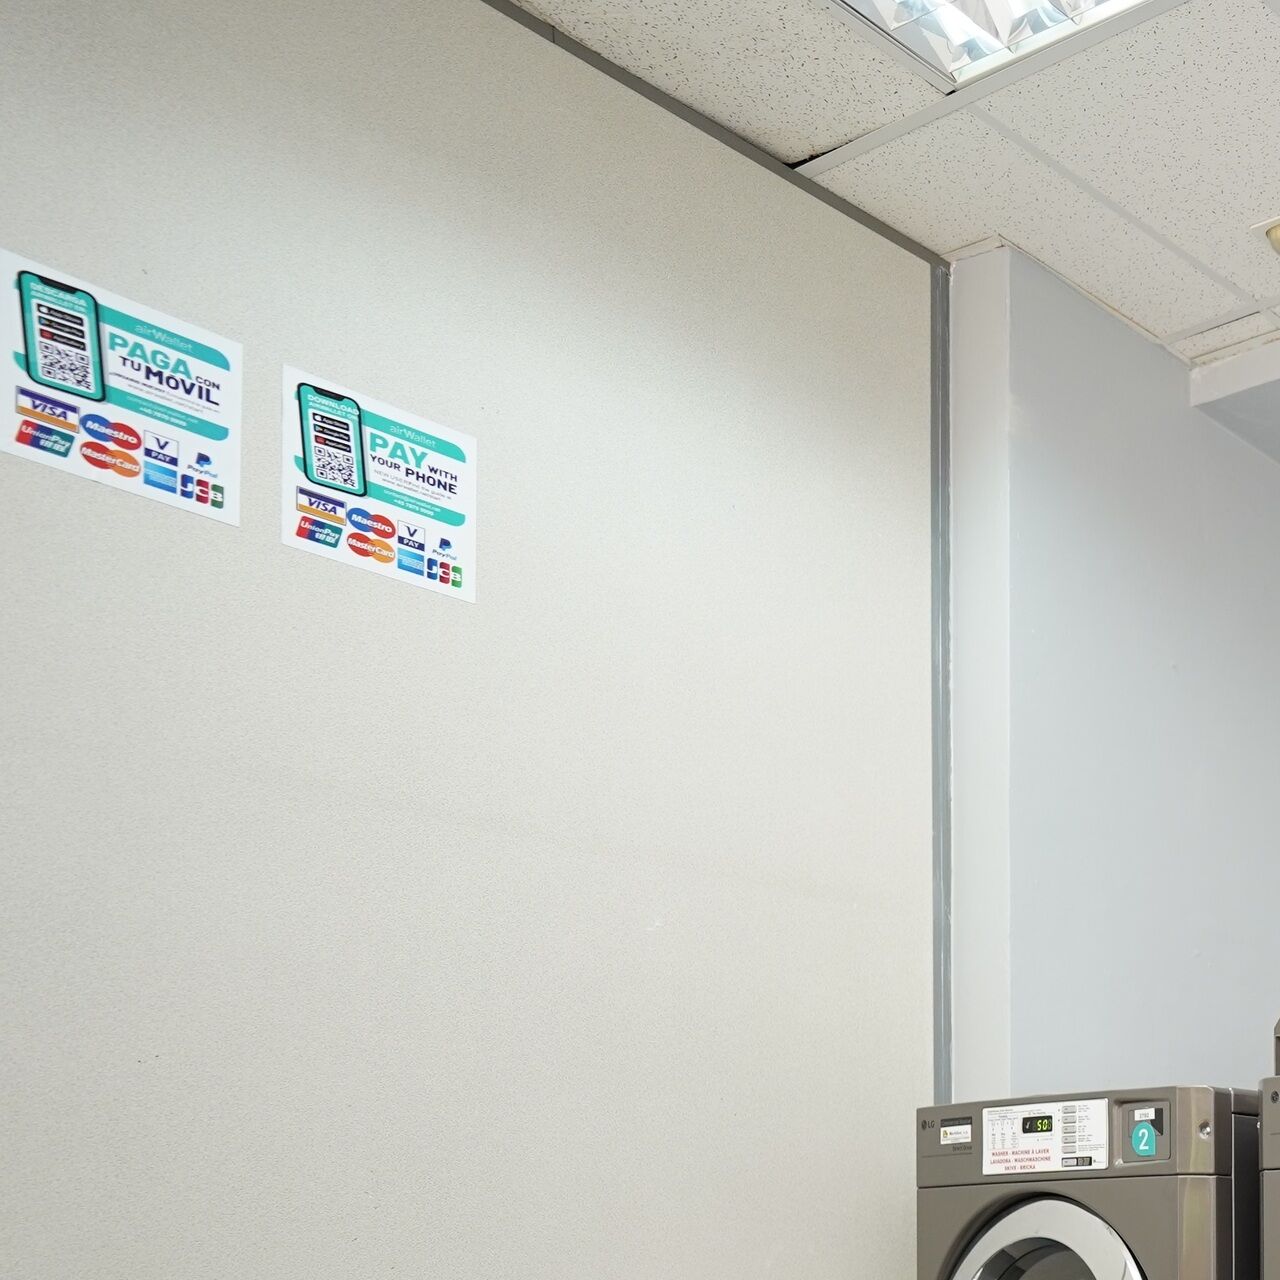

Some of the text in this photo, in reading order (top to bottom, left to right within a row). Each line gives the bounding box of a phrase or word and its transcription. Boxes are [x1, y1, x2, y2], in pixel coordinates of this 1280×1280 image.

[109, 332, 192, 379] PAGA
[196, 376, 219, 390] CON
[119, 356, 141, 371] TU
[31, 400, 68, 420] VISA
[308, 395, 359, 415] DOWNLOAD
[22, 425, 70, 447] UnionPay
[86, 420, 138, 444] Maestro
[390, 426, 436, 447] airWallet
[152, 436, 168, 450] V
[82, 447, 140, 472] MasterCard
[152, 451, 172, 462] PAY
[370, 433, 458, 482] PAY WITH
[188, 464, 218, 478] PayPal
[370, 454, 401, 471] YOUR
[405, 467, 457, 495] PHONE
[182, 479, 224, 504] JCB
[308, 498, 337, 515] VISA
[301, 521, 340, 539] UnionPay
[352, 514, 393, 533] Maestro
[405, 526, 418, 537] V
[349, 538, 394, 558] MasterCard
[404, 538, 420, 549] PAY
[433, 549, 458, 561] PayPal
[427, 561, 462, 584] JCB
[928, 1120, 935, 1129] LG
[1138, 1128, 1149, 1150] 2
